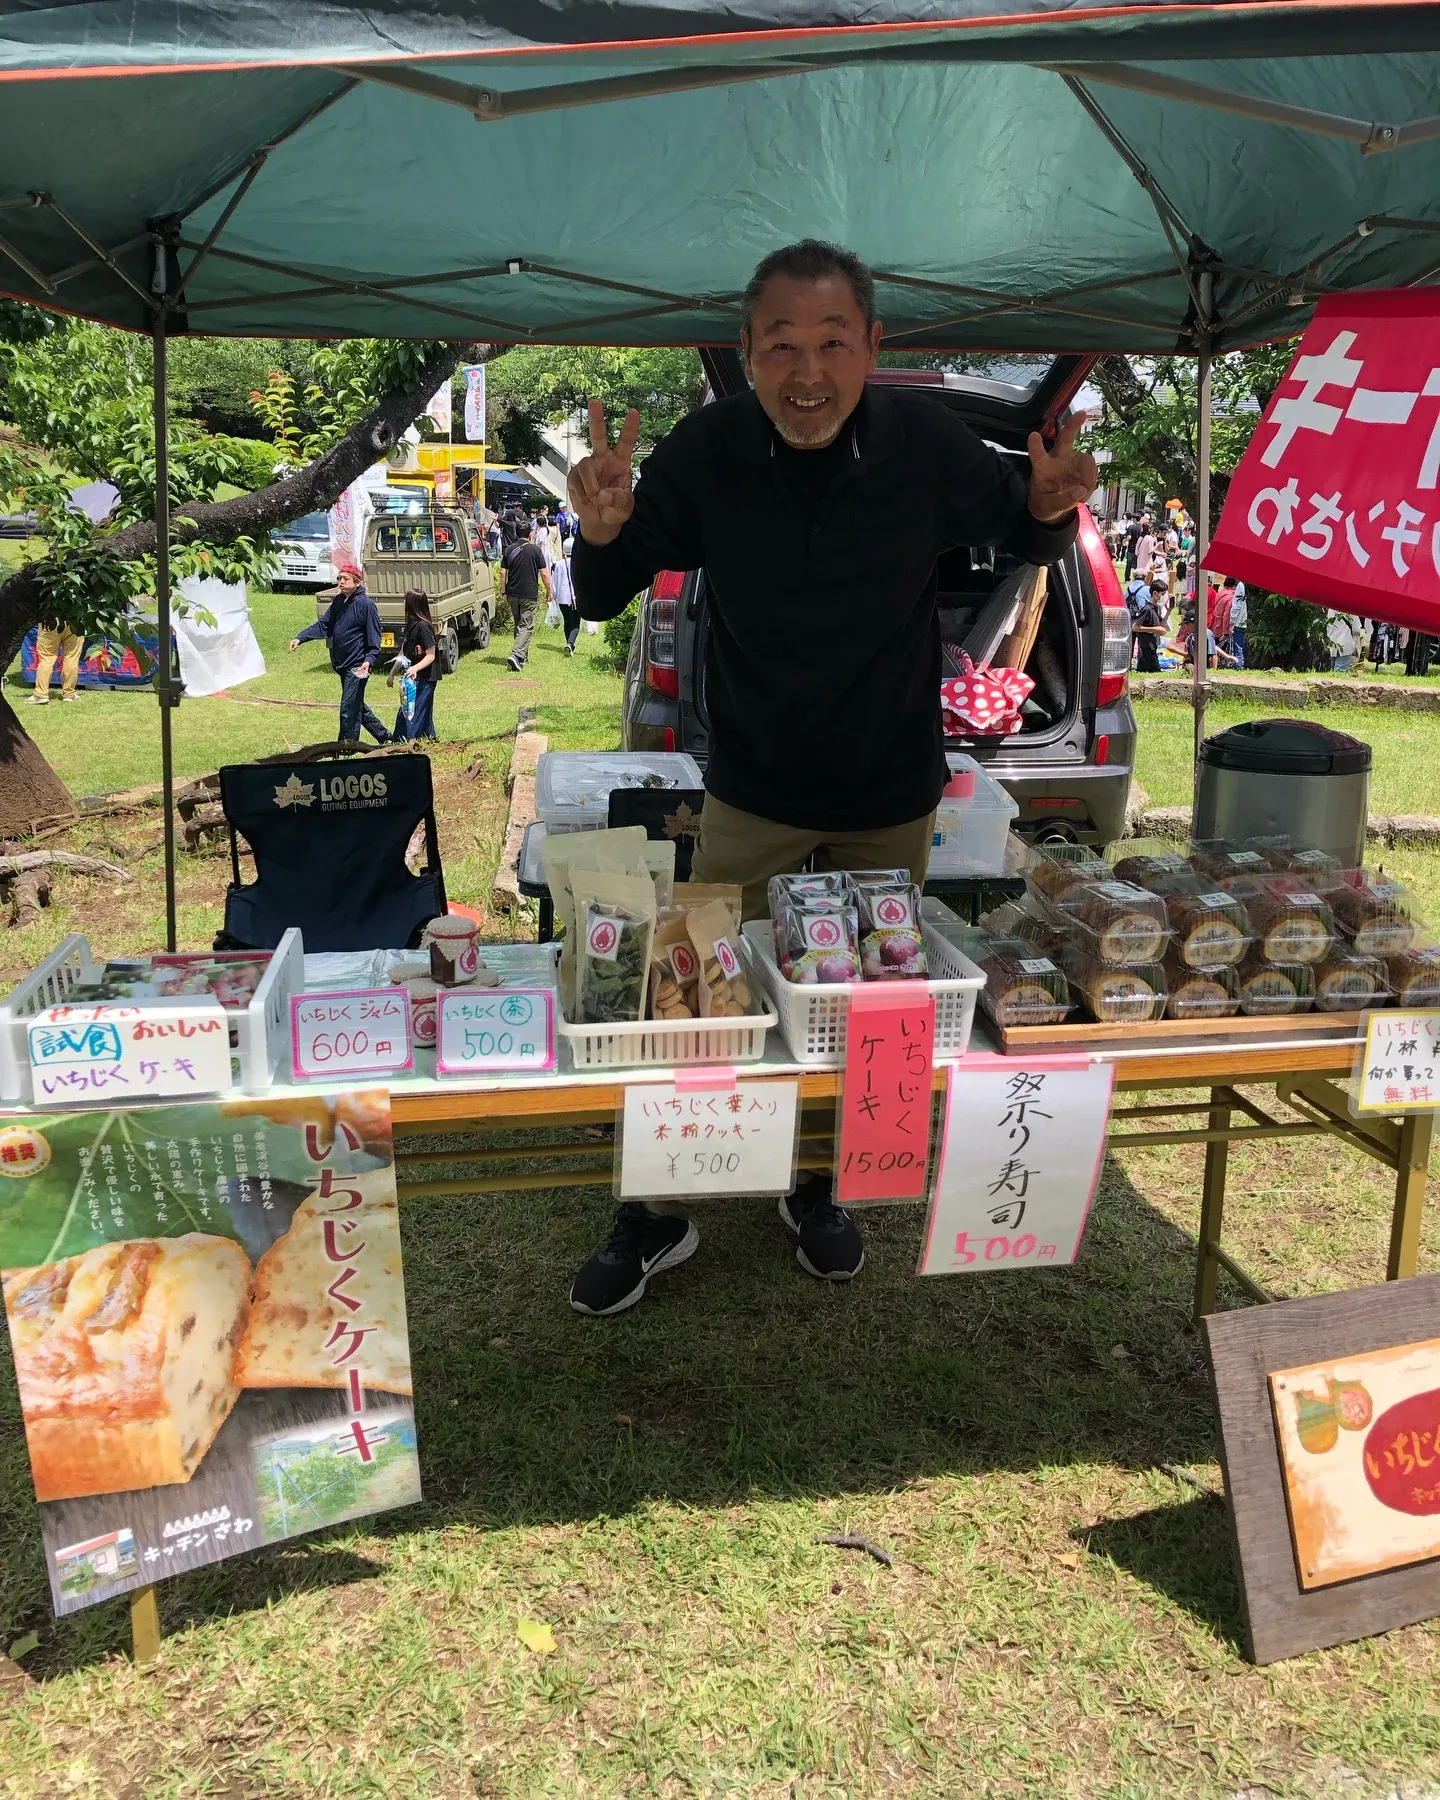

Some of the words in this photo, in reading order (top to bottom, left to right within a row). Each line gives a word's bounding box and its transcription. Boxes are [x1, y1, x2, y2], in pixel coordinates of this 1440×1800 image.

[320, 773, 387, 801] LOGOS
[321, 801, 347, 812] OUTING
[350, 797, 388, 810] EQUIPMENT
[36, 1024, 120, 1058] 試食
[132, 1019, 222, 1041] おいしい
[1377, 1020, 1440, 1037] いちじく
[856, 1035, 886, 1121] ケーキ
[894, 1017, 926, 1135] いちじく
[1383, 1085, 1433, 1104] 無料
[643, 1093, 778, 1118] いちじく葉入り
[654, 1121, 762, 1142] 米粉クッキー
[986, 1071, 1055, 1231] 祭り寿司
[1, 1142, 36, 1164] 推奨
[122, 1143, 142, 1193] いちじくの
[210, 1136, 231, 1204] いちじく農家の
[232, 1132, 252, 1202] 自然に囲まれた
[843, 1150, 926, 1174] 1500円
[78, 1146, 105, 1235] お楽しみください。
[100, 1144, 125, 1227] 贅沢で優しい味を
[144, 1140, 169, 1222] 美しい水で育った
[188, 1136, 213, 1221] 手作りケーキです。
[950, 1231, 1058, 1266] 500円
[304, 1121, 388, 1463] いちじくケーキ
